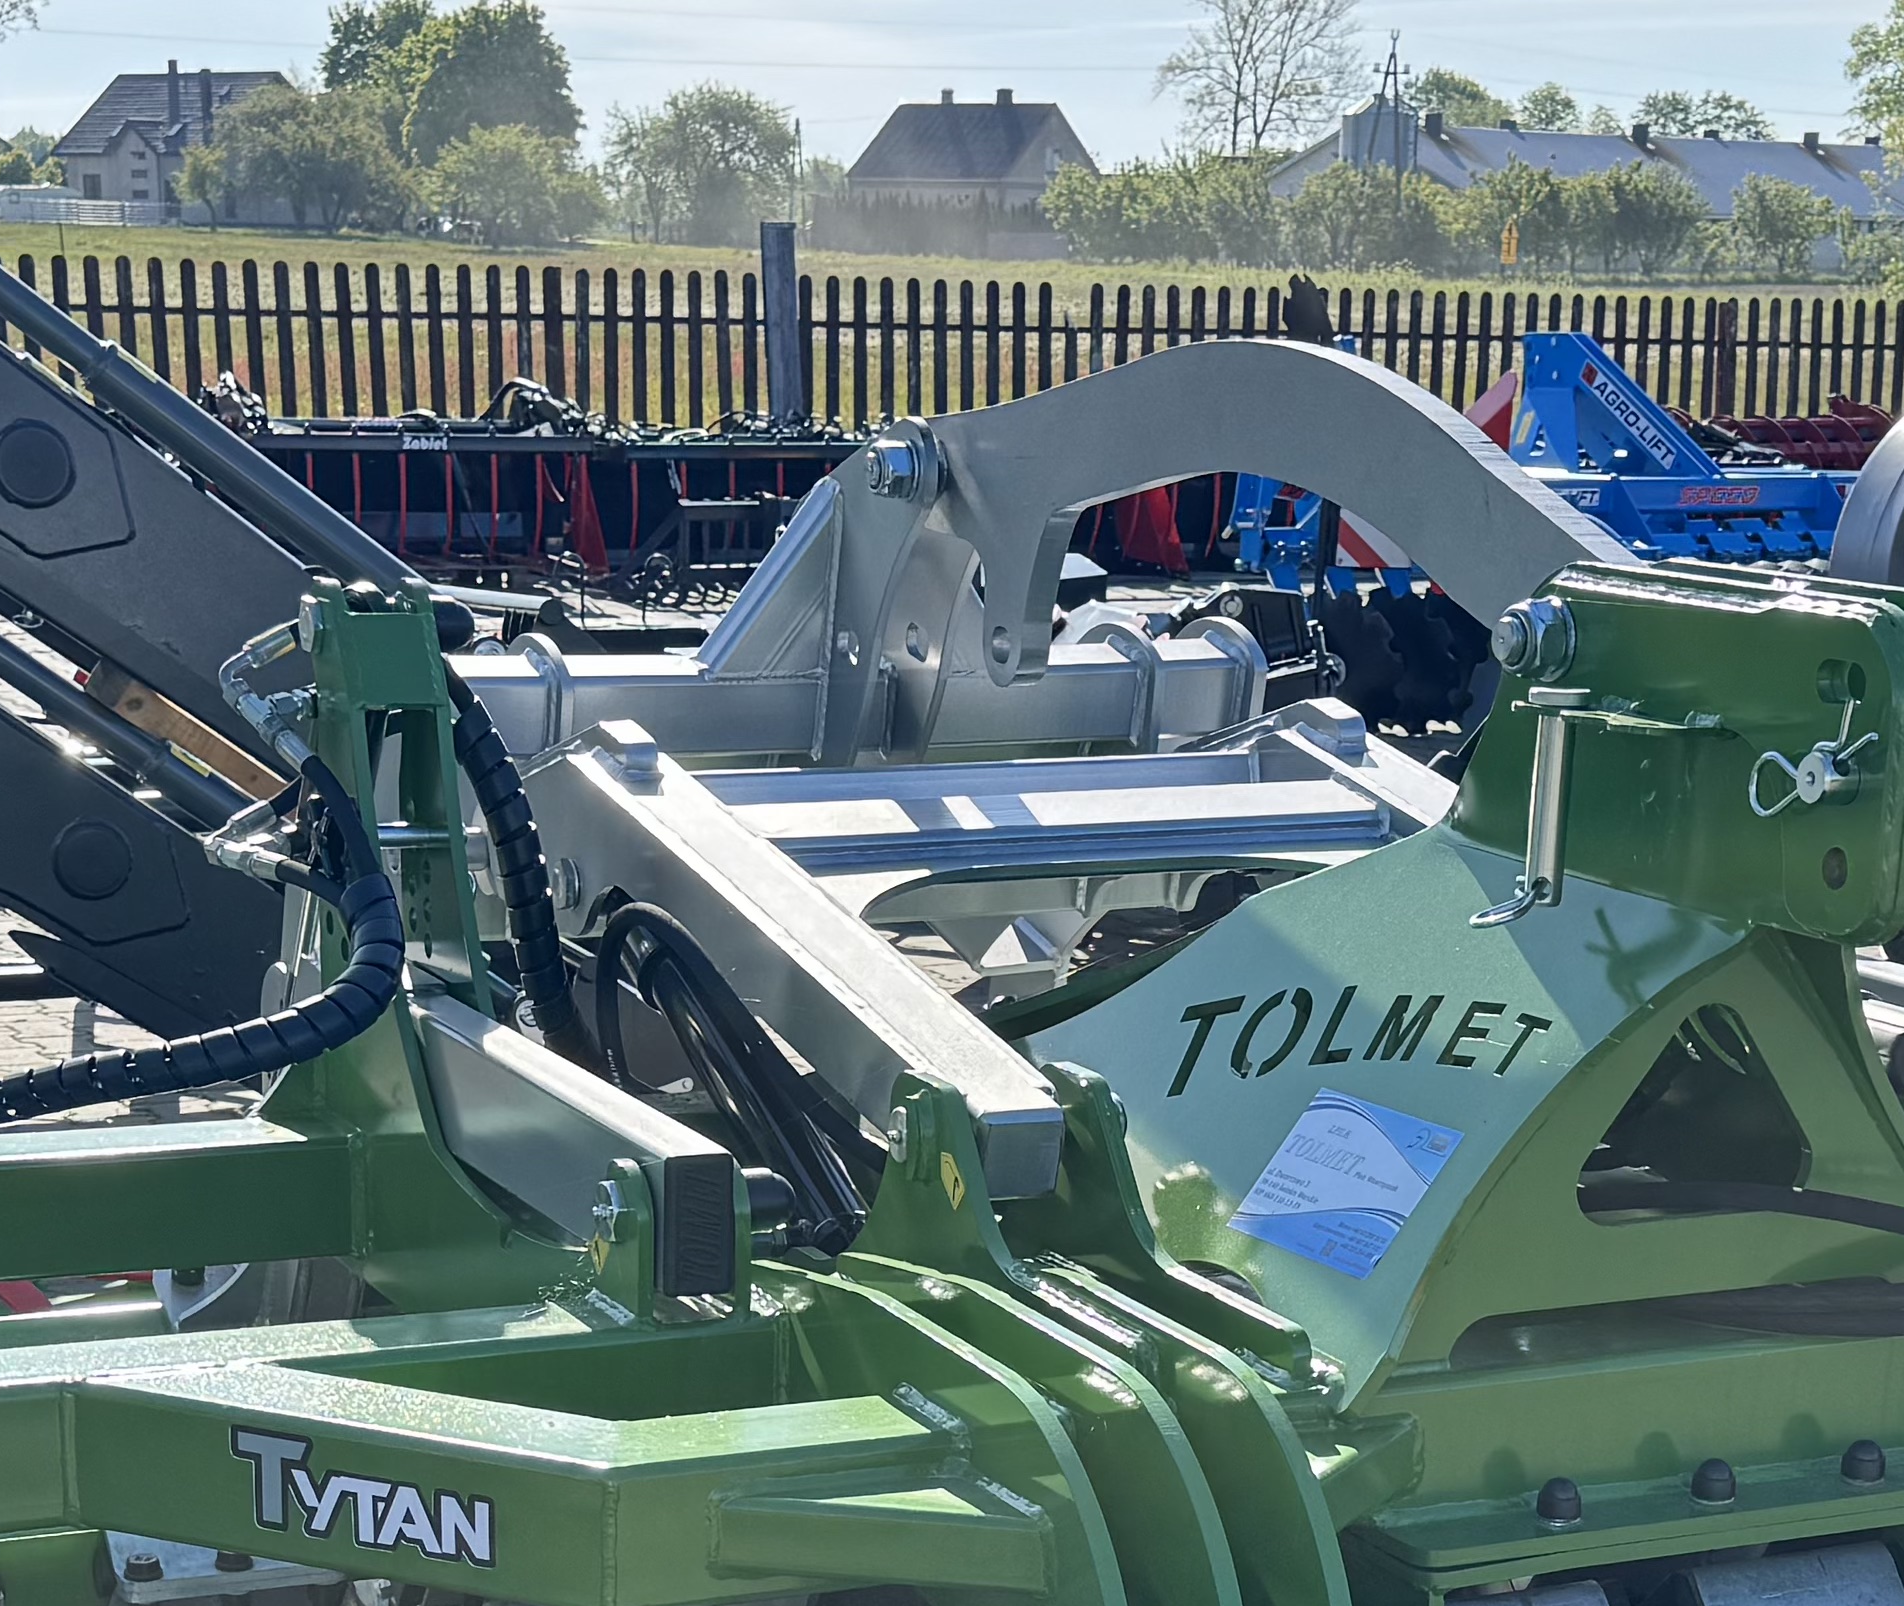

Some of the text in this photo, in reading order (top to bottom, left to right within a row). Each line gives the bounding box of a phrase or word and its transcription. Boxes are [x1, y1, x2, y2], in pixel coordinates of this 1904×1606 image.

[1594, 381, 1675, 461] AGRO-LIFT
[1166, 985, 1553, 1098] TOLMET
[1285, 1133, 1366, 1176] TOLMET
[229, 1424, 496, 1569] TYTAN
